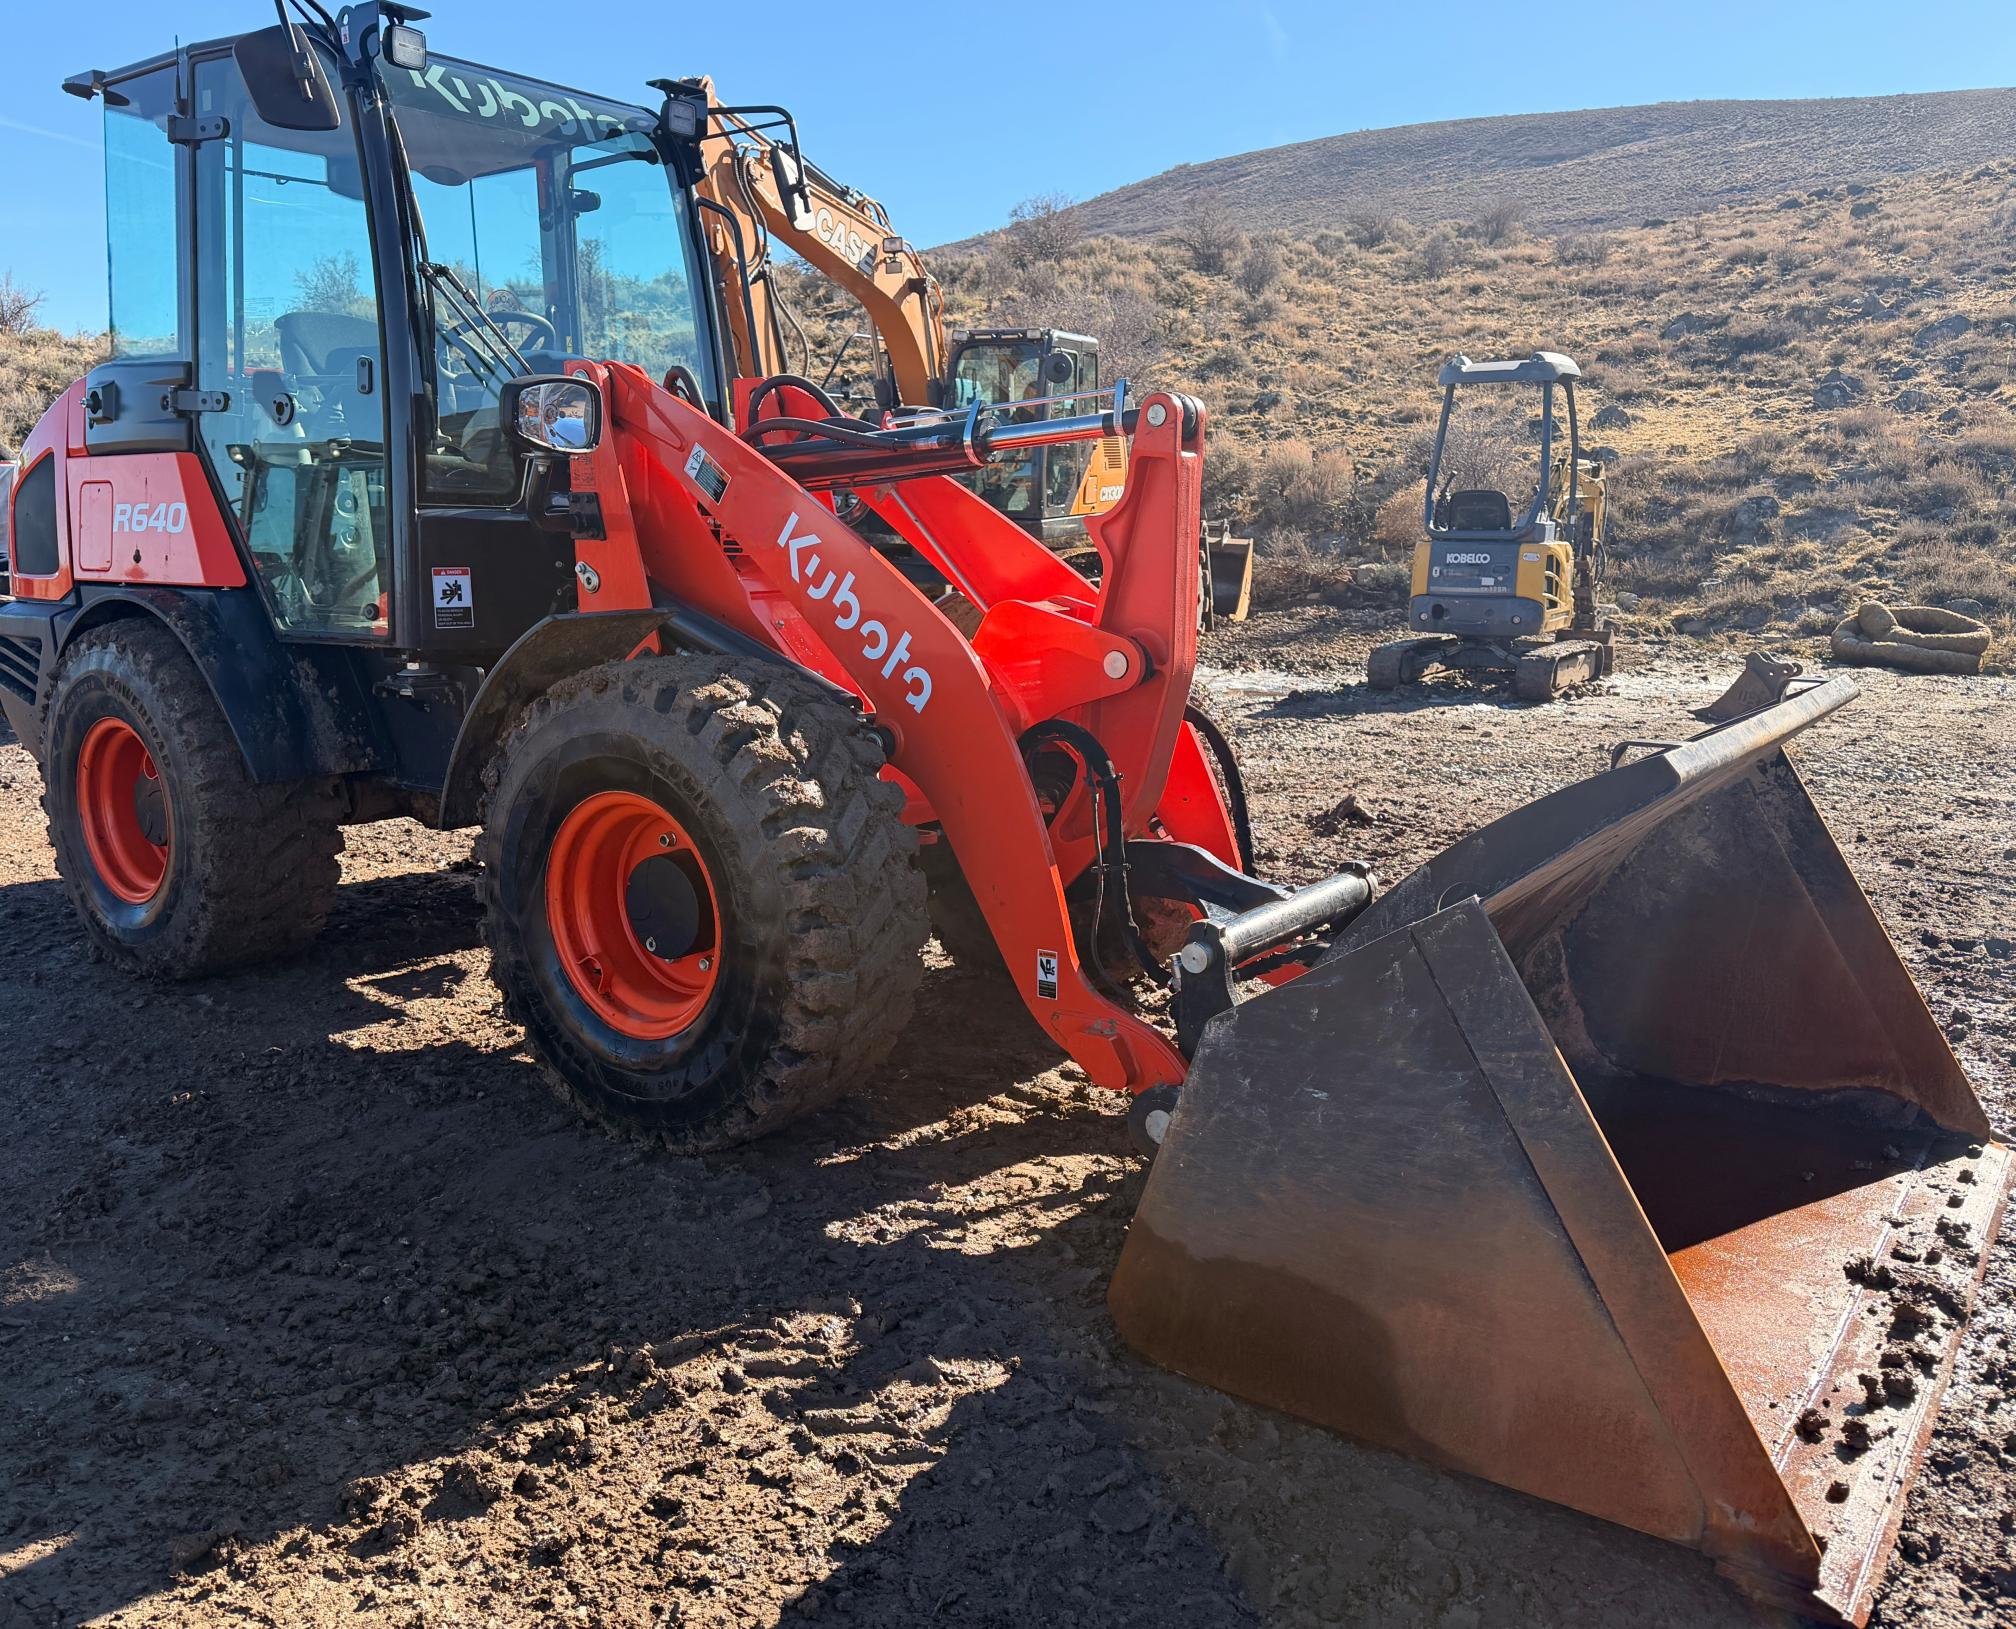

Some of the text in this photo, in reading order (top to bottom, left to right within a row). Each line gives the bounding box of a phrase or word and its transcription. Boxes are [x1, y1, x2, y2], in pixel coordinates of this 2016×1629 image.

[113, 502, 187, 534] R640
[1446, 552, 1490, 564] KOBELCO
[777, 511, 932, 714] Kubota
